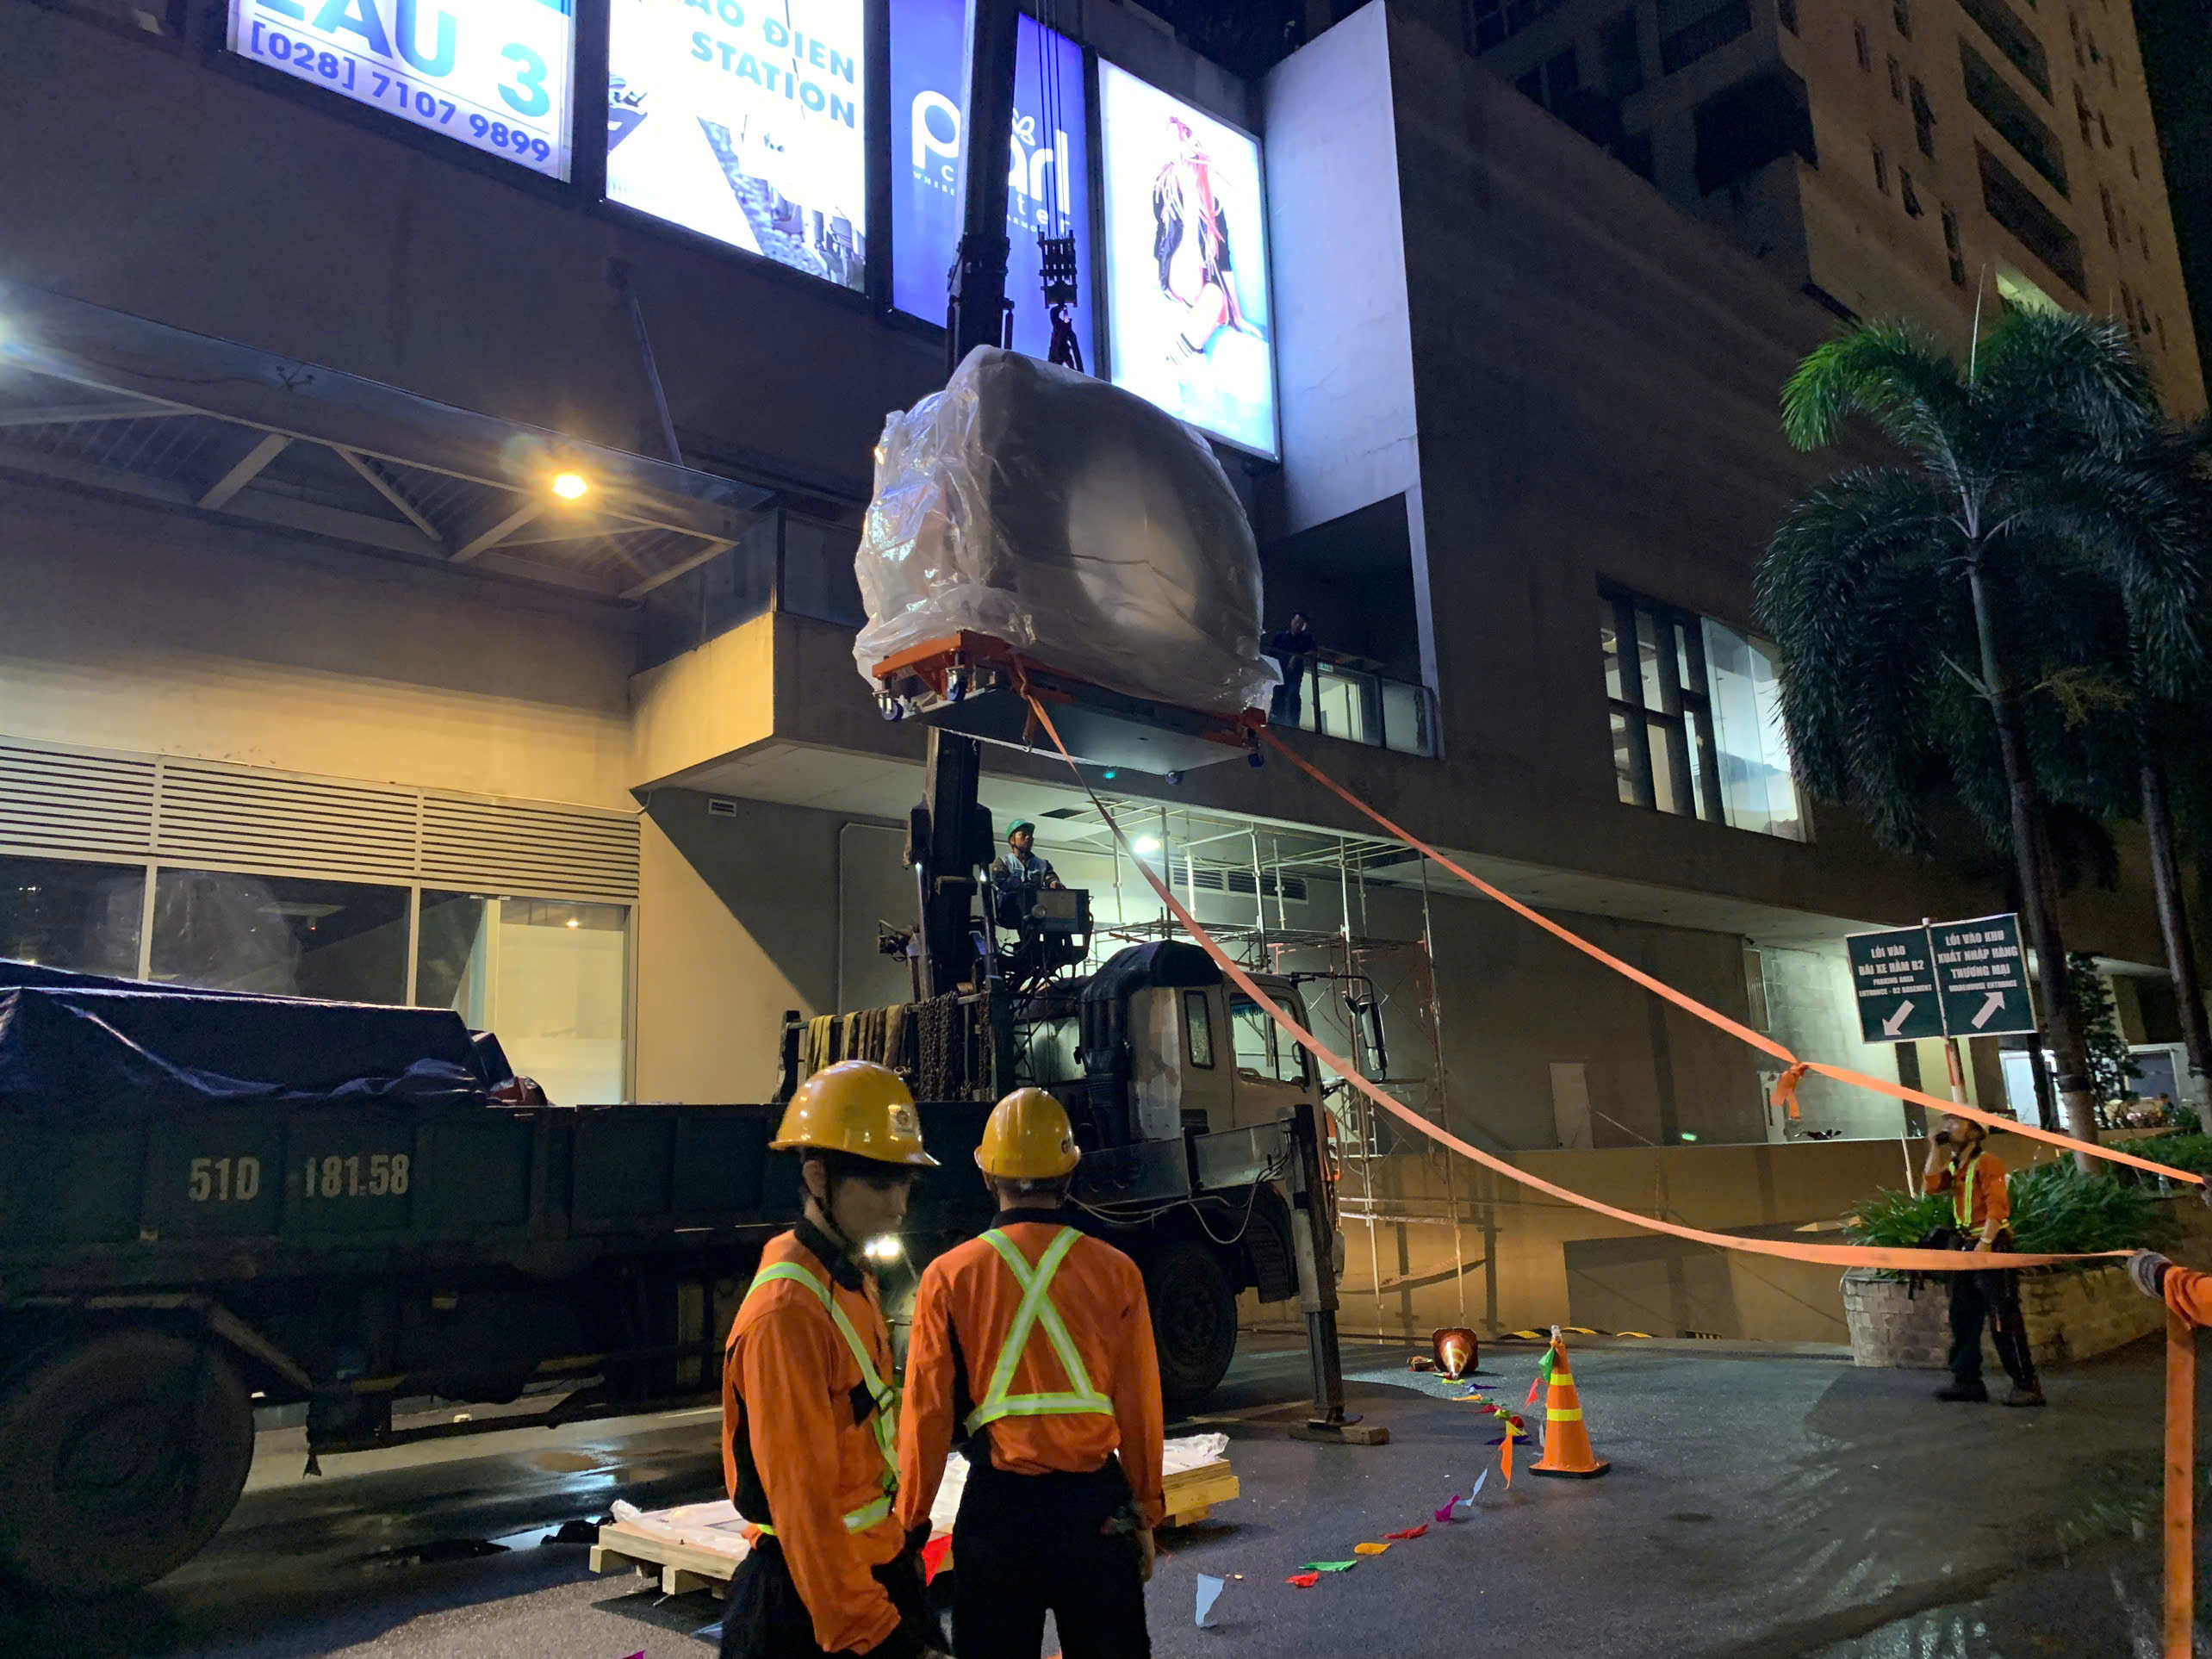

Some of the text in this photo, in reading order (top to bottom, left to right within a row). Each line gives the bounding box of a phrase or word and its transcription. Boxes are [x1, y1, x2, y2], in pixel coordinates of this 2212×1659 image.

[371, 71, 457, 125] 7107
[469, 113, 551, 163] 9899
[497, 42, 551, 118] 3
[691, 31, 854, 129] STATION
[1911, 960, 1924, 971] B2
